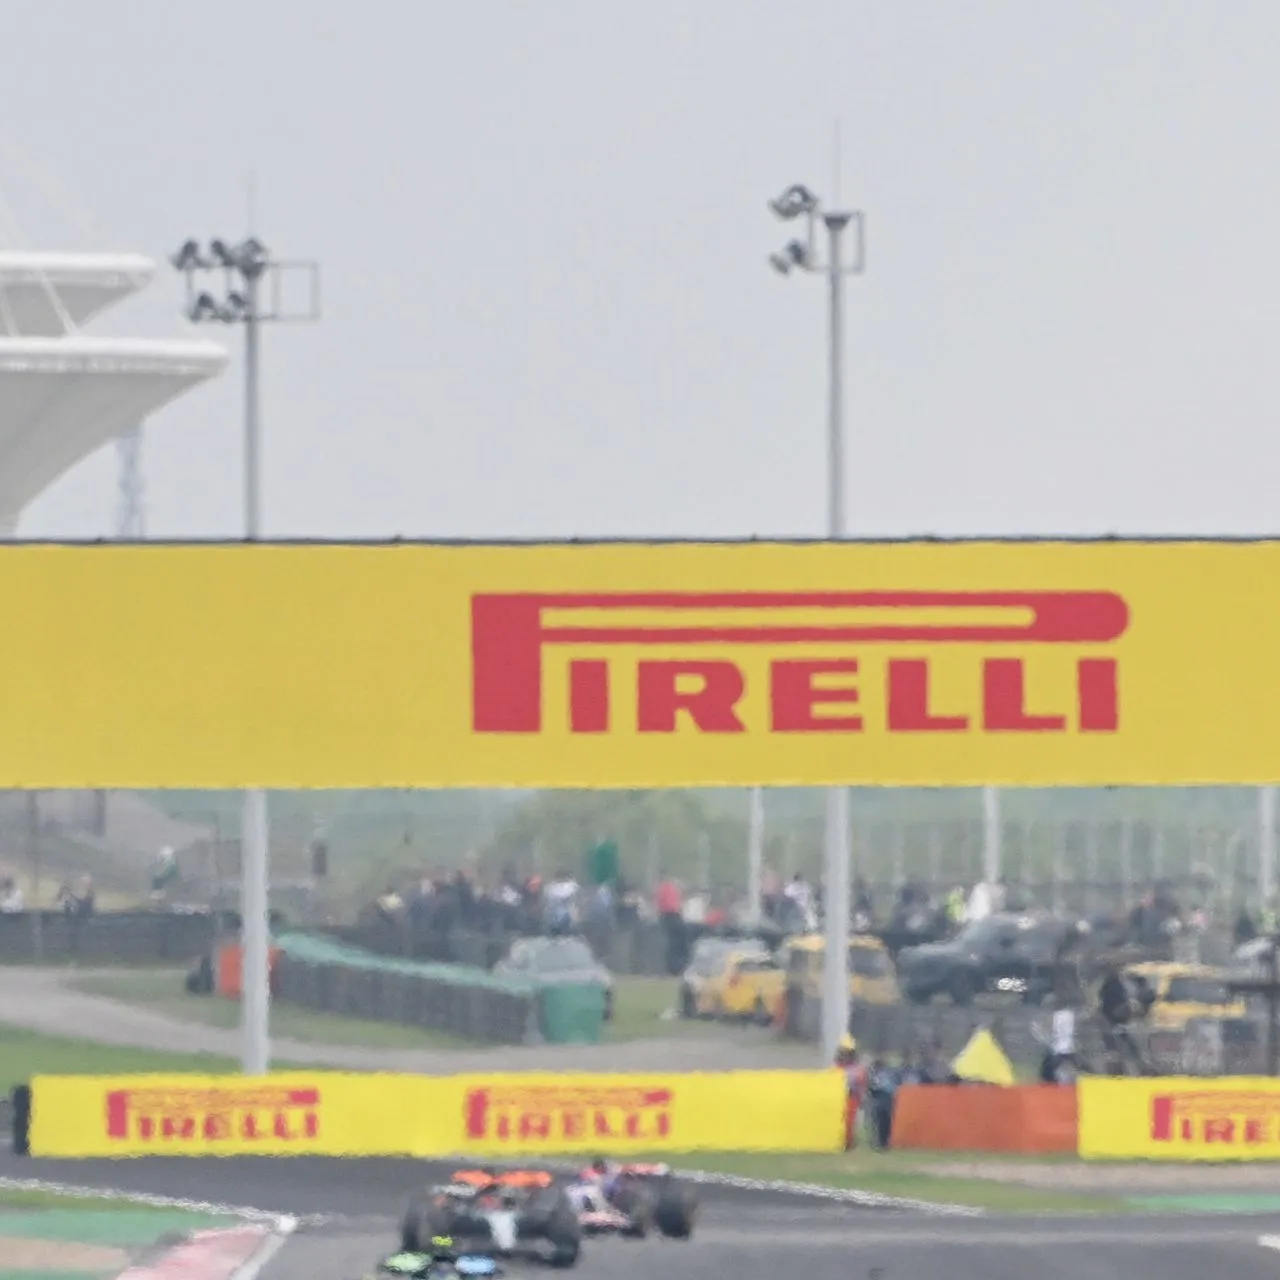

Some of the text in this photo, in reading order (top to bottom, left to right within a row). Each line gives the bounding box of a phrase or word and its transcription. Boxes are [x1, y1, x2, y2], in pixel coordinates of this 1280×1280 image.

[469, 588, 1131, 735] PIRELLI
[105, 1087, 321, 1141] PIRELLI
[465, 1086, 674, 1141] PIRELLI
